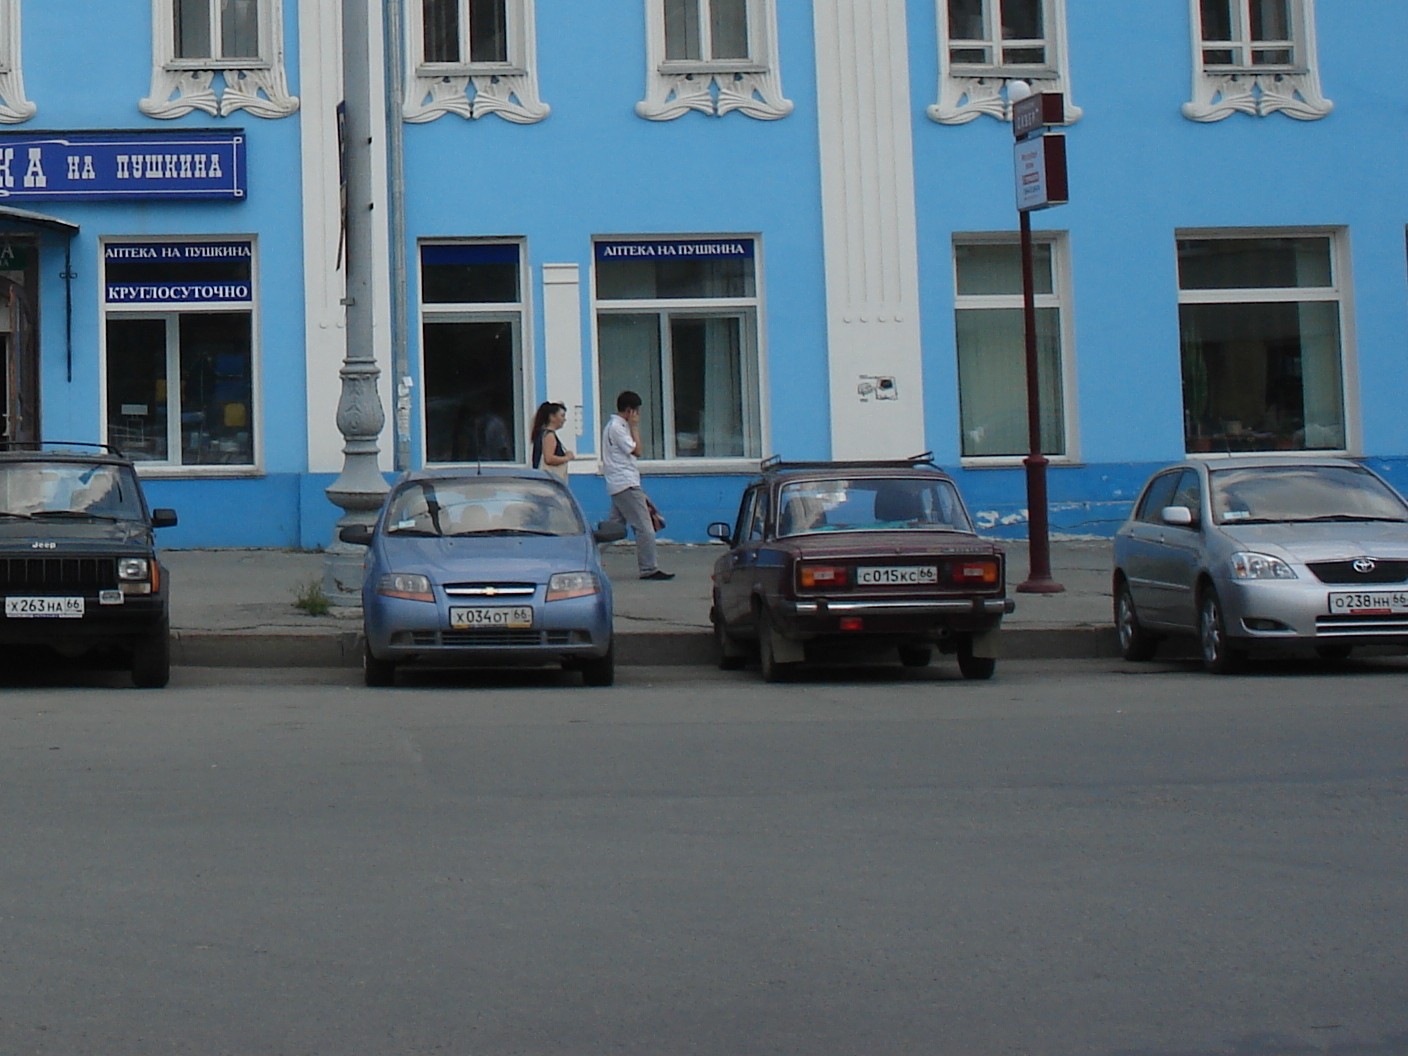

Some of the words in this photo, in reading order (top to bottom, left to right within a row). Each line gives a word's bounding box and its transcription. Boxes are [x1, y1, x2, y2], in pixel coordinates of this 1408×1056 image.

[67, 156, 96, 180] НА
[117, 154, 223, 179] ПУШКИНА
[106, 248, 157, 258] АПТЕКА
[162, 247, 181, 257] НА
[185, 246, 251, 257] ПУШКИНА
[604, 246, 655, 256] АПТЕКА
[658, 245, 677, 255] НА
[679, 244, 744, 255] ПУШКИНА
[109, 286, 248, 299] КРУГЛОСУТОЧНО
